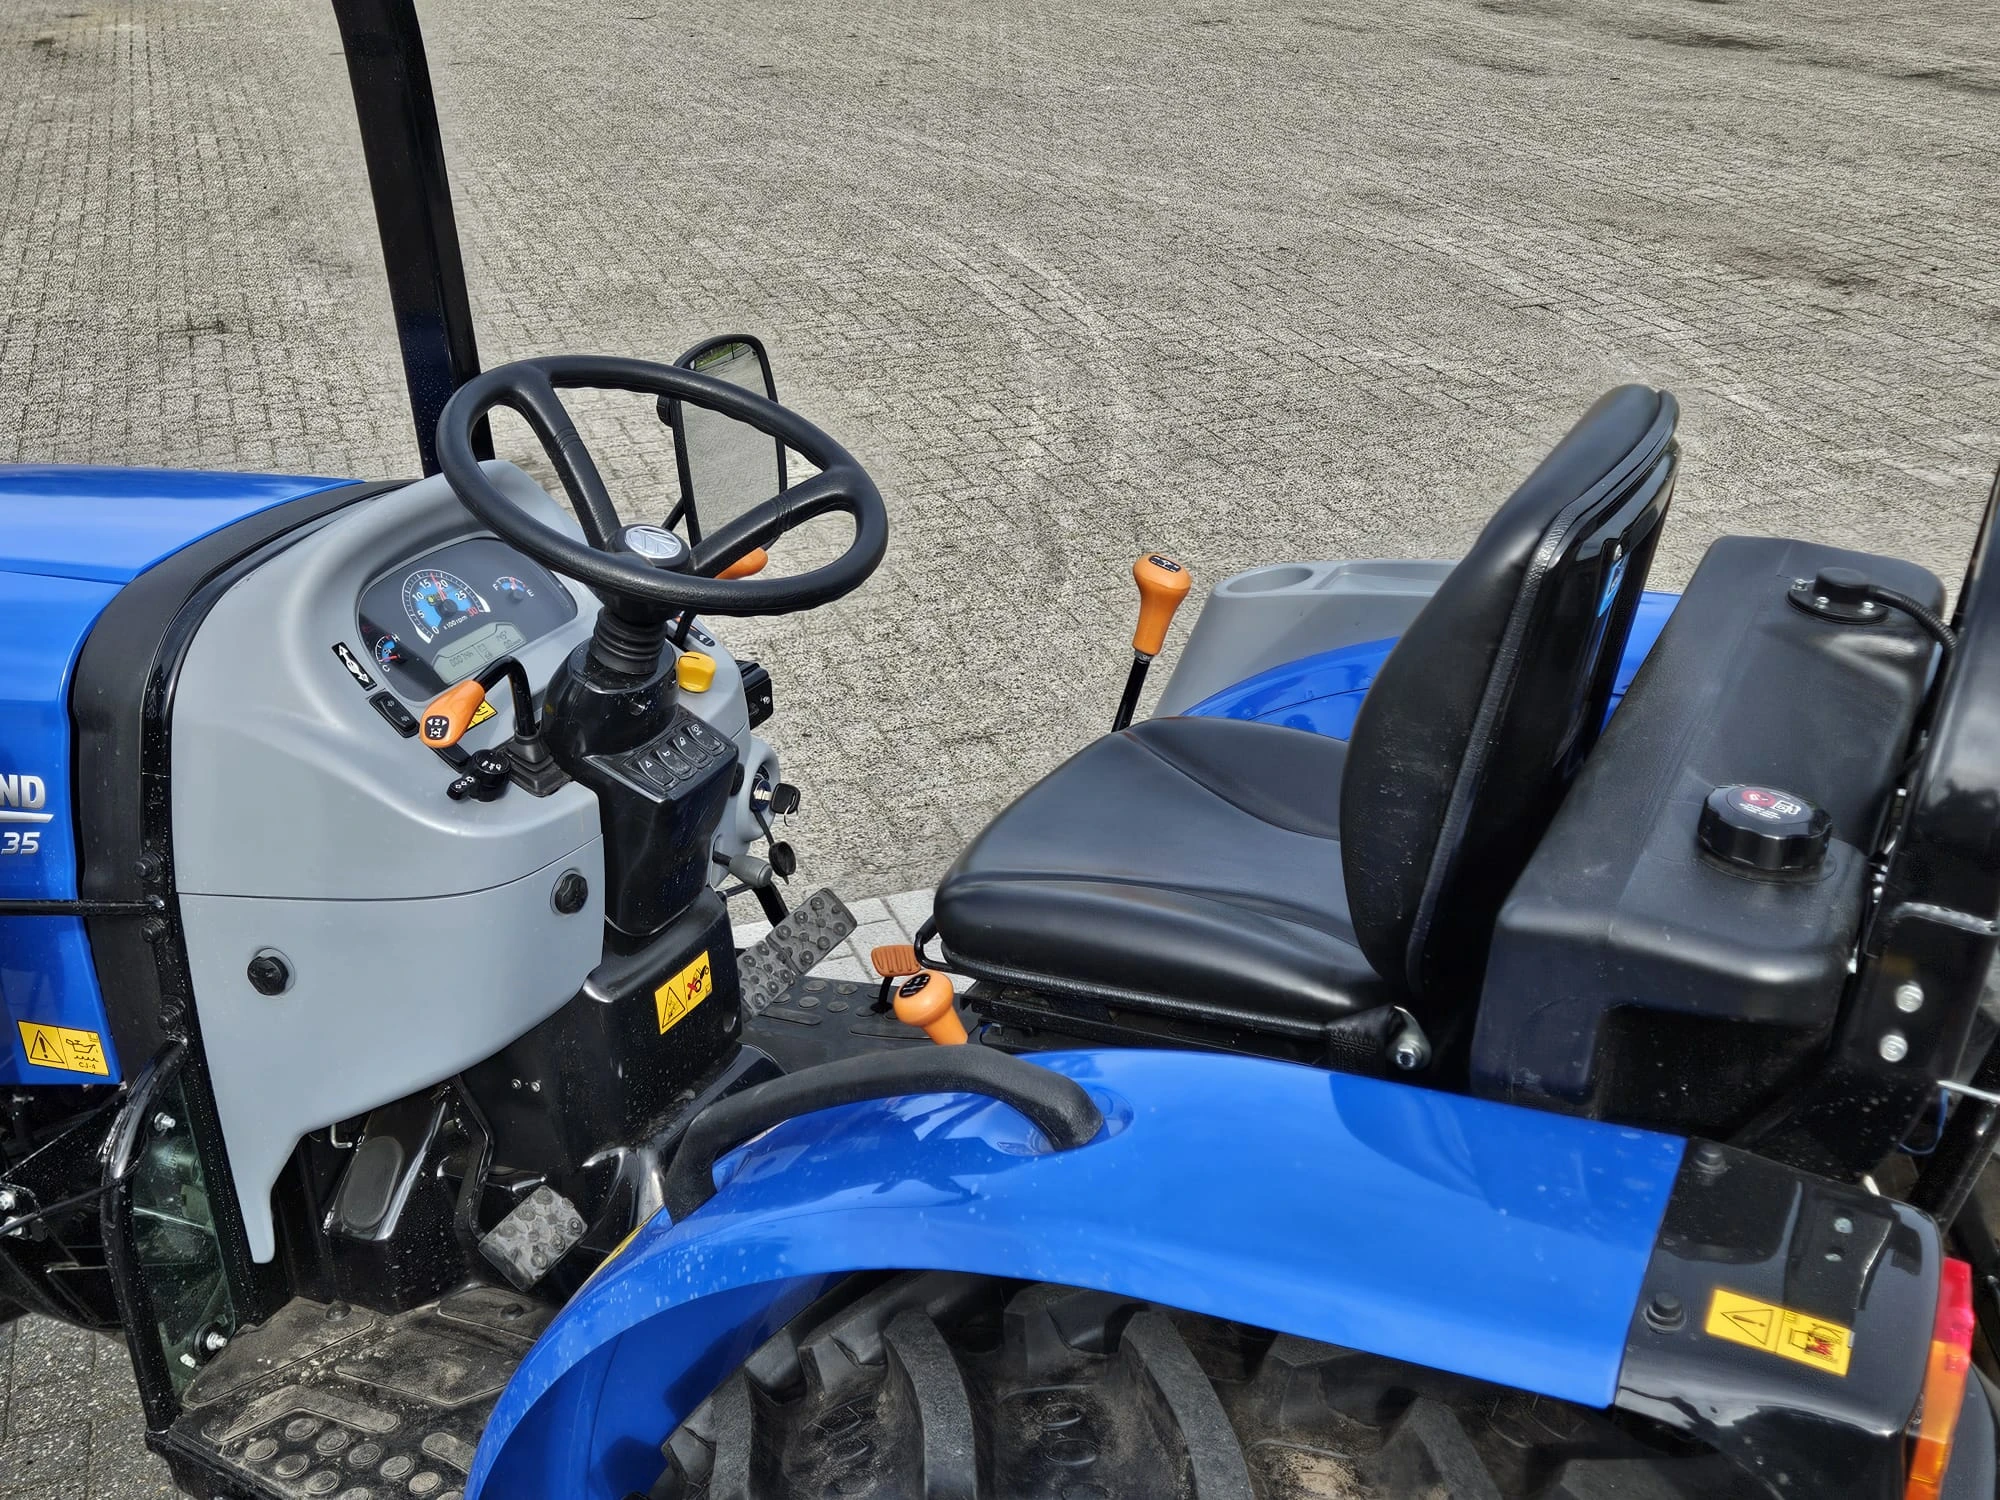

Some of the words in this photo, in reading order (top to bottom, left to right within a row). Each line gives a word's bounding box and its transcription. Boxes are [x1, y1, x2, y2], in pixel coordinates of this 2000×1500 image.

[419, 579, 432, 590] 15
[492, 583, 498, 591] F
[412, 592, 424, 602] 10
[455, 590, 467, 601] 25
[526, 588, 534, 597] E
[417, 610, 425, 619] 5
[467, 606, 479, 617] 30
[432, 626, 440, 634] 0
[391, 633, 400, 643] H
[382, 664, 390, 672] C
[0, 774, 46, 810] ND
[1, 831, 41, 855] 35
